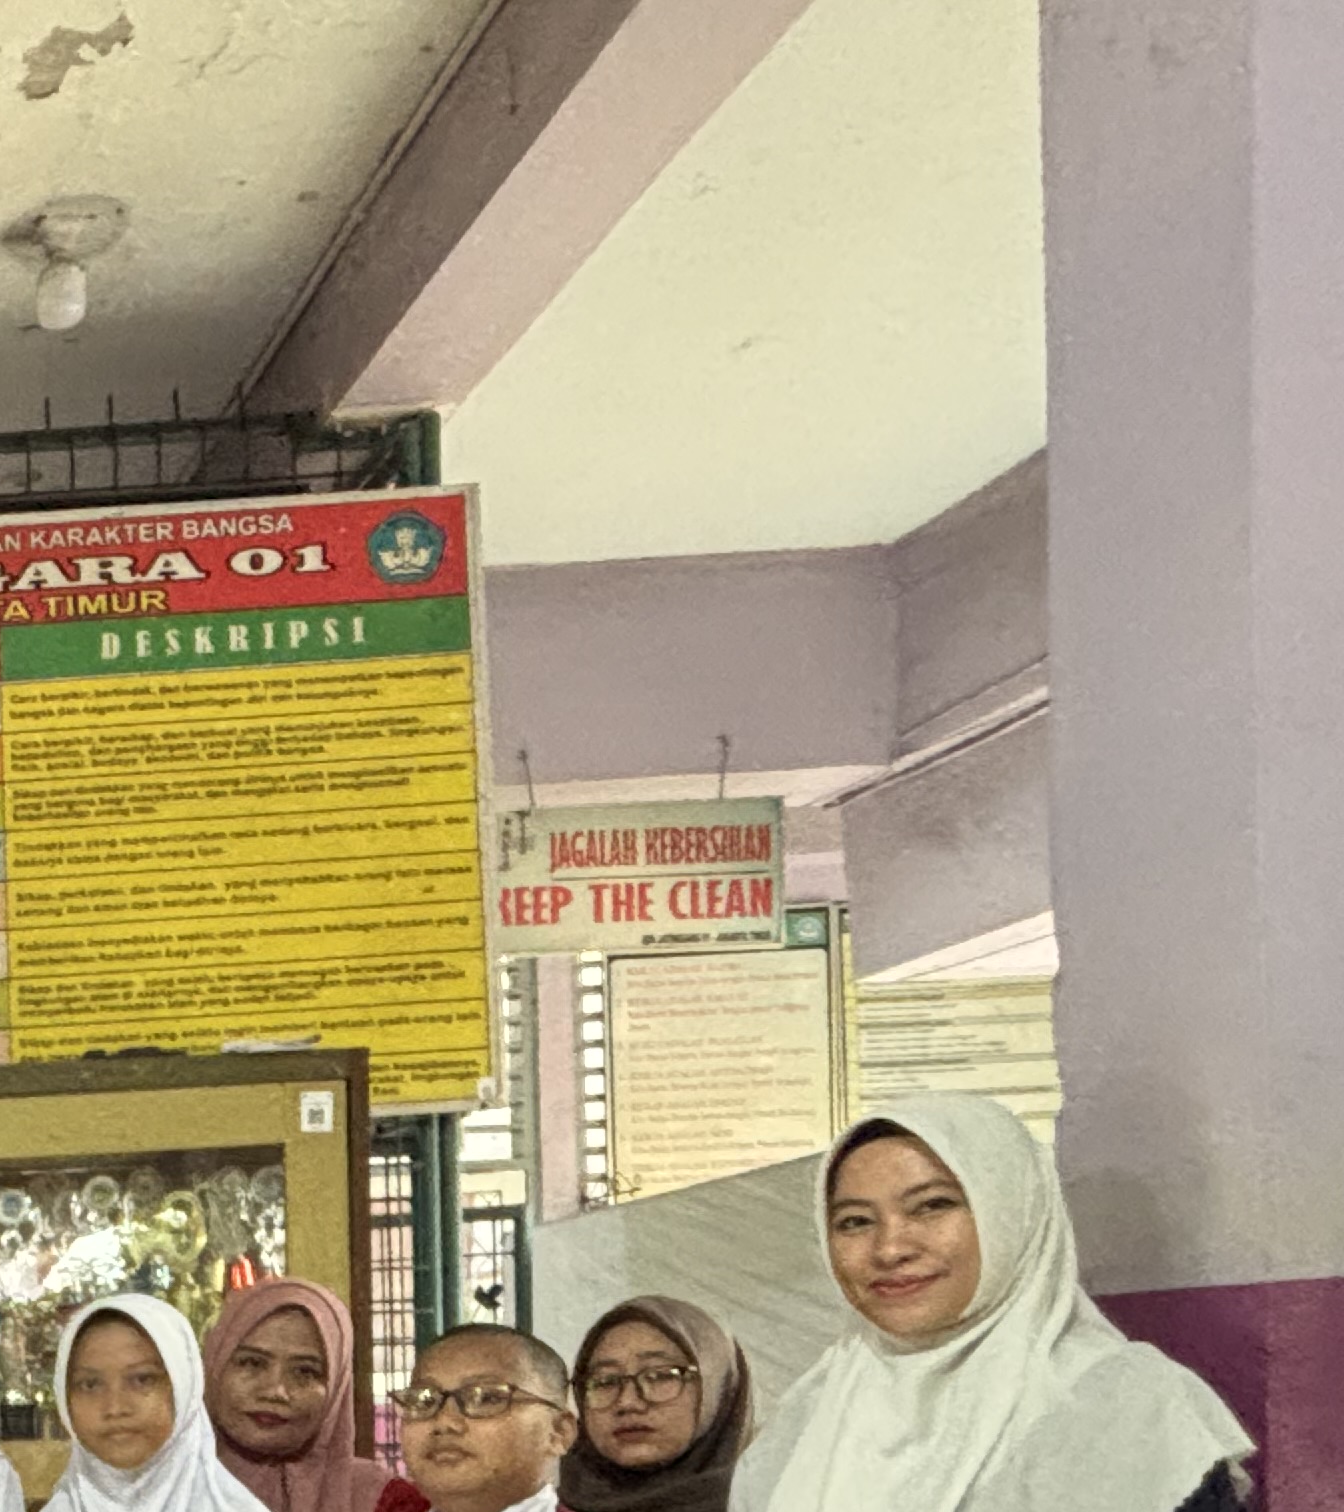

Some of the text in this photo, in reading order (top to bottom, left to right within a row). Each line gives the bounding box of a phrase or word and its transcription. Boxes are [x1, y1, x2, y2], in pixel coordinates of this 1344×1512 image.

[30, 518, 174, 549] KARAKTER
[181, 512, 295, 540] BANGSA
[229, 544, 333, 577] 01
[43, 589, 168, 618] TIMUR
[100, 615, 367, 661] DESKRIPSI
[549, 822, 773, 874] JAGALAH KEBERSIHAN
[587, 881, 656, 924] THE
[668, 877, 774, 921] CLEAN
